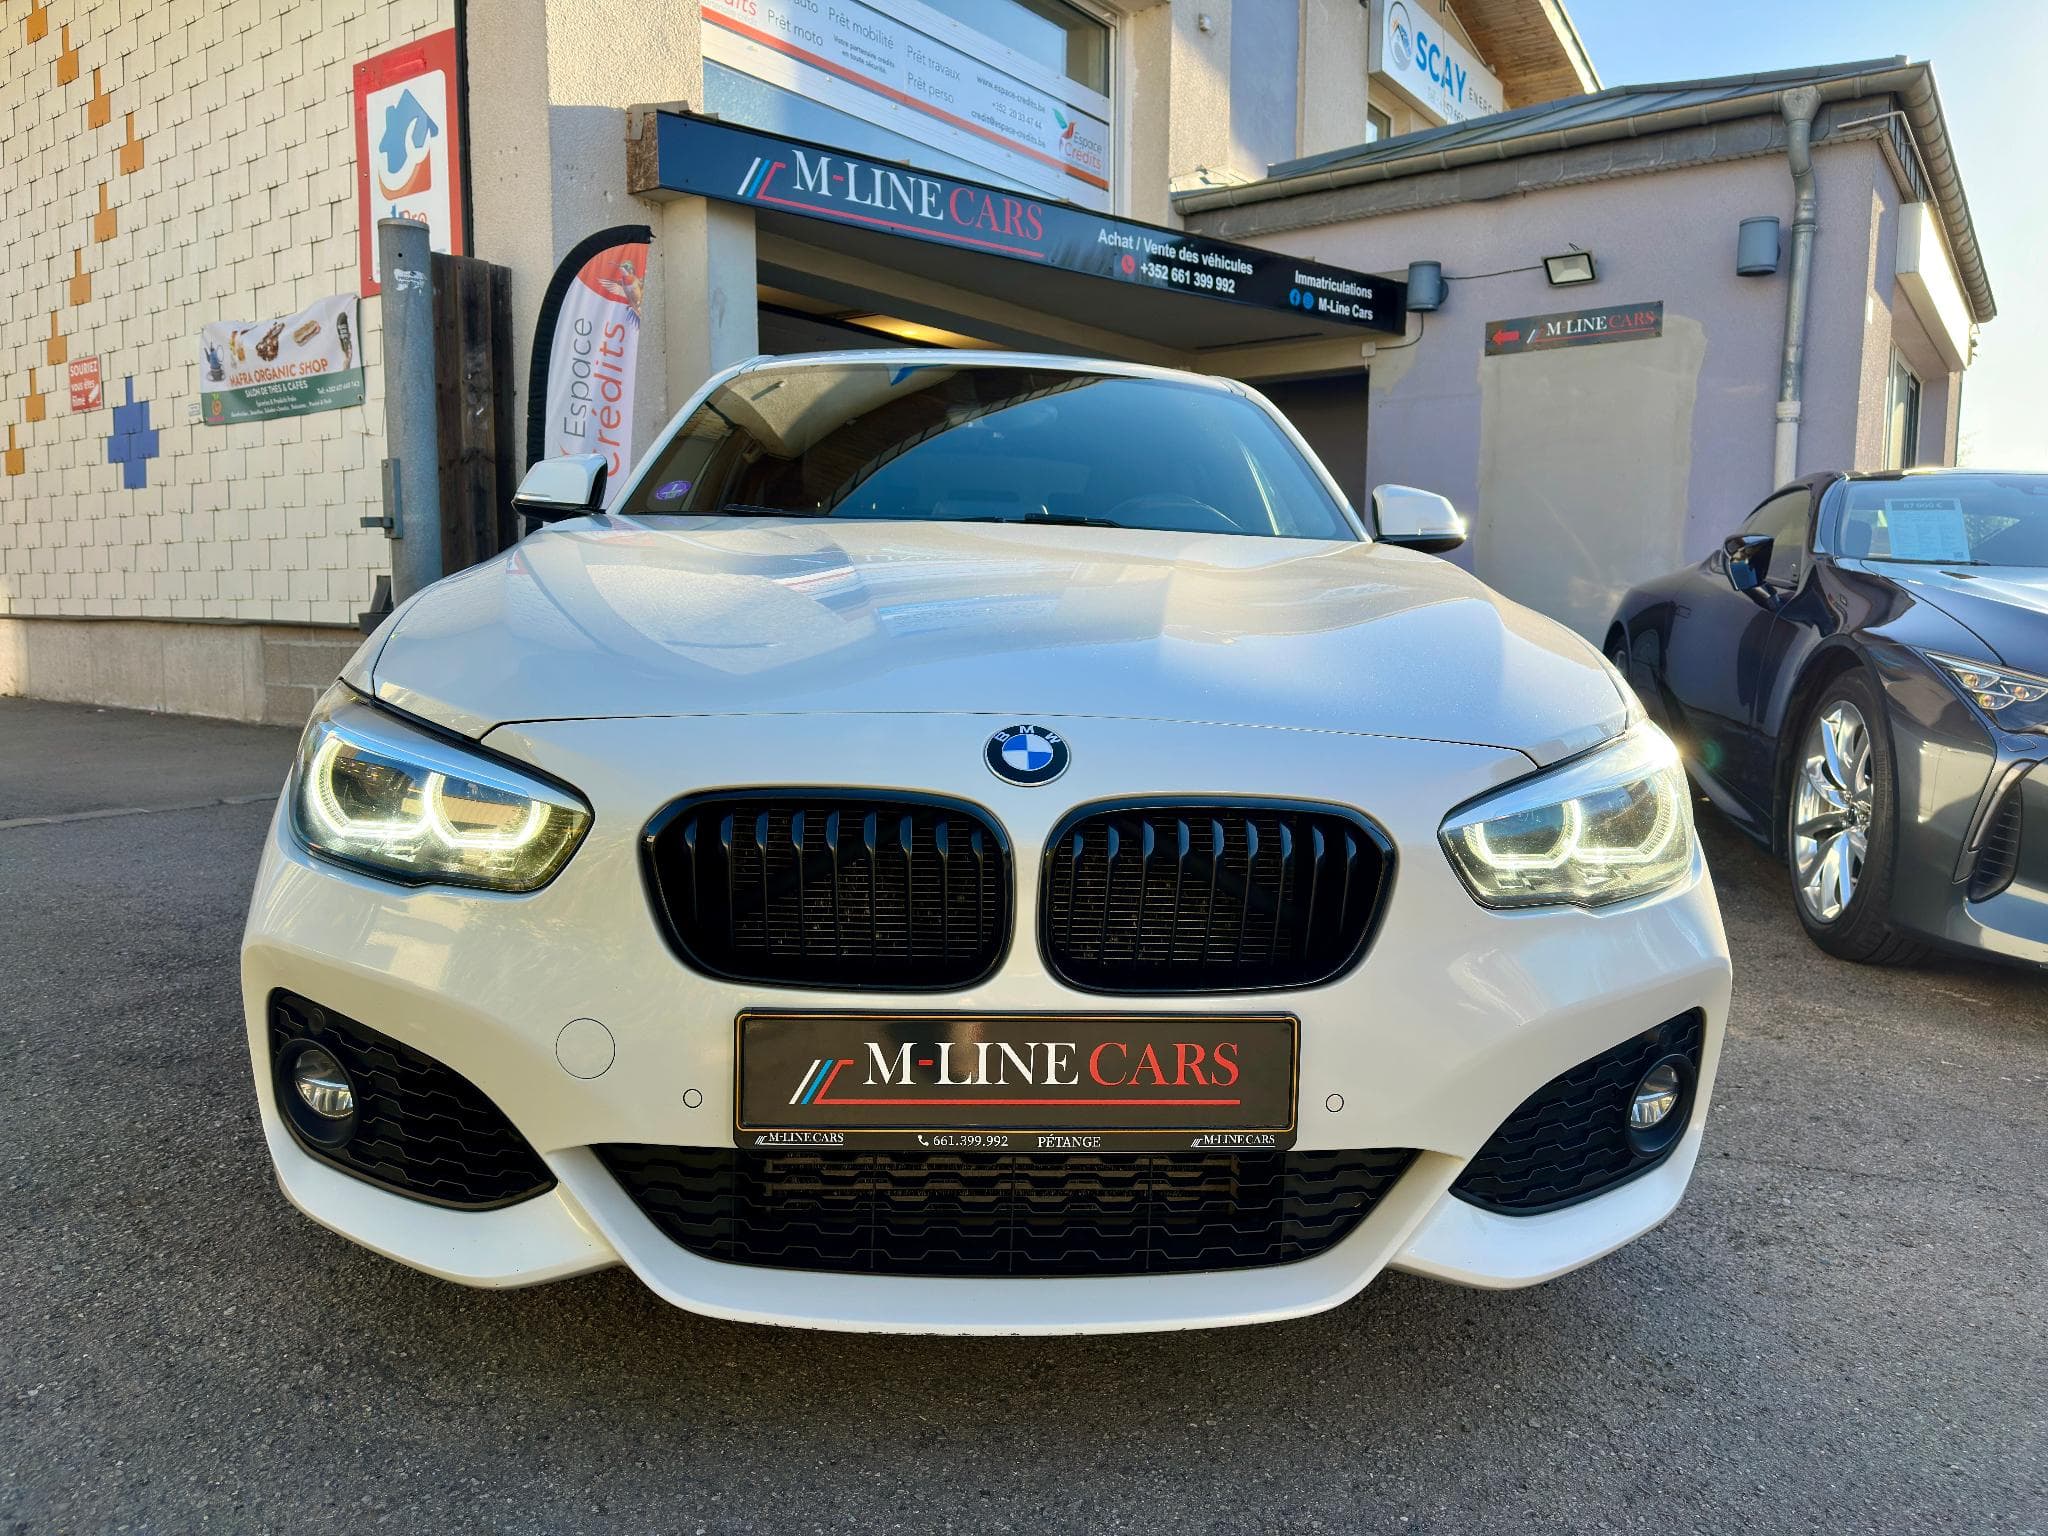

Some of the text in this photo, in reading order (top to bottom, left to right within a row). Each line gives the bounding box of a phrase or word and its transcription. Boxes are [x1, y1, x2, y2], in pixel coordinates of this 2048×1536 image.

[768, 8, 791, 32] Prêt
[794, 24, 824, 46] moto
[829, 7, 894, 49] Prêt mobilité
[907, 45, 960, 81] Prêt travaux
[1416, 31, 1467, 103] SCAY
[907, 72, 954, 103] Prêt perso
[1074, 131, 1103, 154] Espace
[792, 149, 1044, 241] M-LINE CARS
[1098, 228, 1253, 275] Achat / Vente des véhicules
[1141, 262, 1235, 294] +352 661 399 992
[1294, 270, 1373, 299] Immatriculations
[1318, 297, 1374, 320] M-Line Cars
[1546, 311, 1656, 337] M-LINE CARS
[254, 364, 297, 382] ORGANIC
[300, 358, 328, 375] SHOP
[563, 318, 593, 438] Espace
[994, 725, 1060, 744] BMW
[862, 1042, 1241, 1086] M-LINE CARS
[813, 1132, 844, 1143] CARS
[933, 1133, 1101, 1148] 661.399.992 PÉTANGE
[1245, 1134, 1275, 1144] CARS
